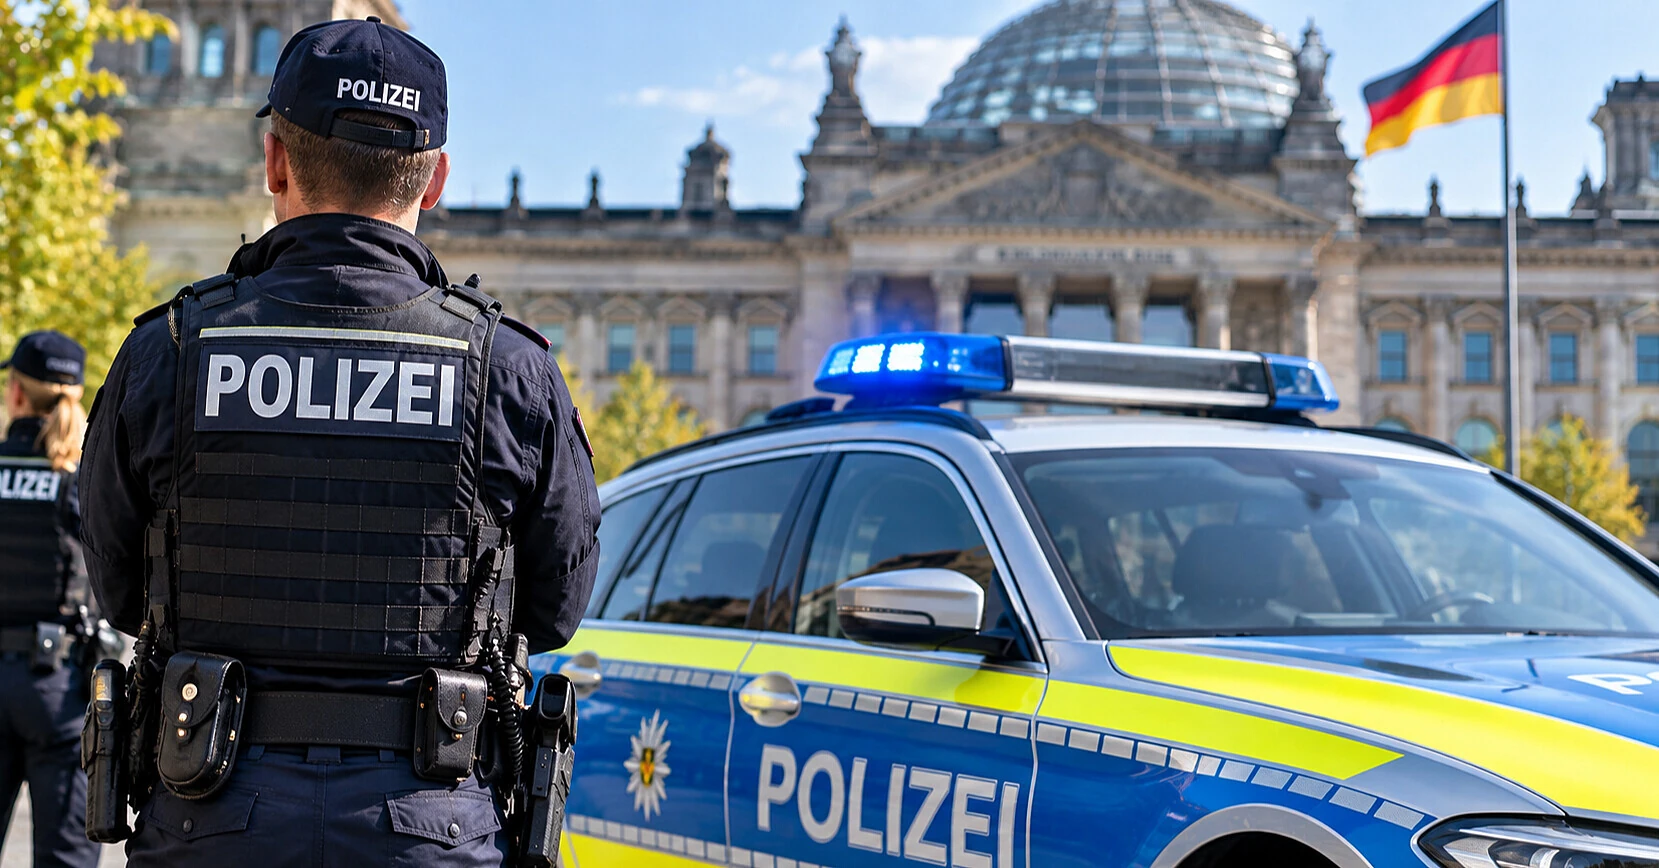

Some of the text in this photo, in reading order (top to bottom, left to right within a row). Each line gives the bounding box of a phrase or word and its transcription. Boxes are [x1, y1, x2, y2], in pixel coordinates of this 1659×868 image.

[336, 78, 421, 112] POLIZEI
[204, 353, 457, 427] POLIZEI
[0, 468, 61, 502] LIZEI
[1567, 671, 1659, 695] P
[757, 743, 1020, 868] POLIZEI
